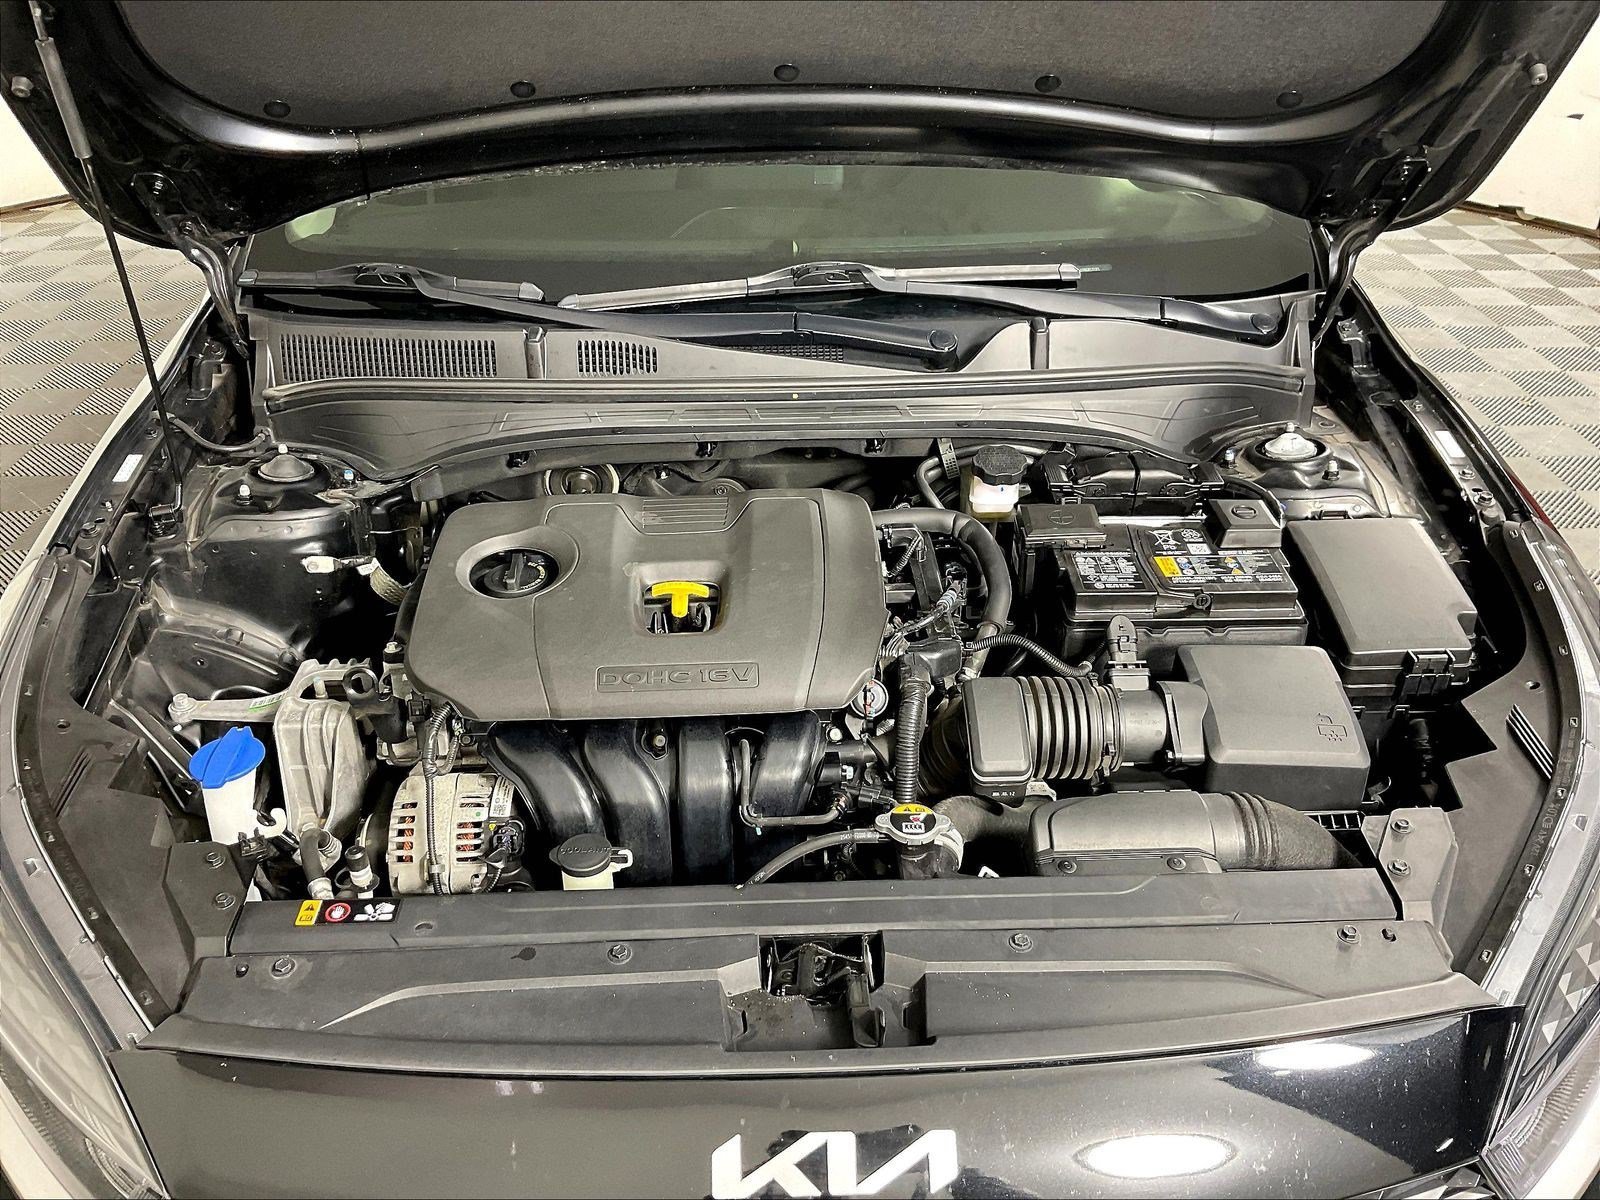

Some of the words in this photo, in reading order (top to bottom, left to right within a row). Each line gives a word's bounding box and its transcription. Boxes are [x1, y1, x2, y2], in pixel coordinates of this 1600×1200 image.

[600, 670, 692, 685] DOHC
[699, 666, 755, 684] 16V
[711, 1129, 959, 1200] KIA
